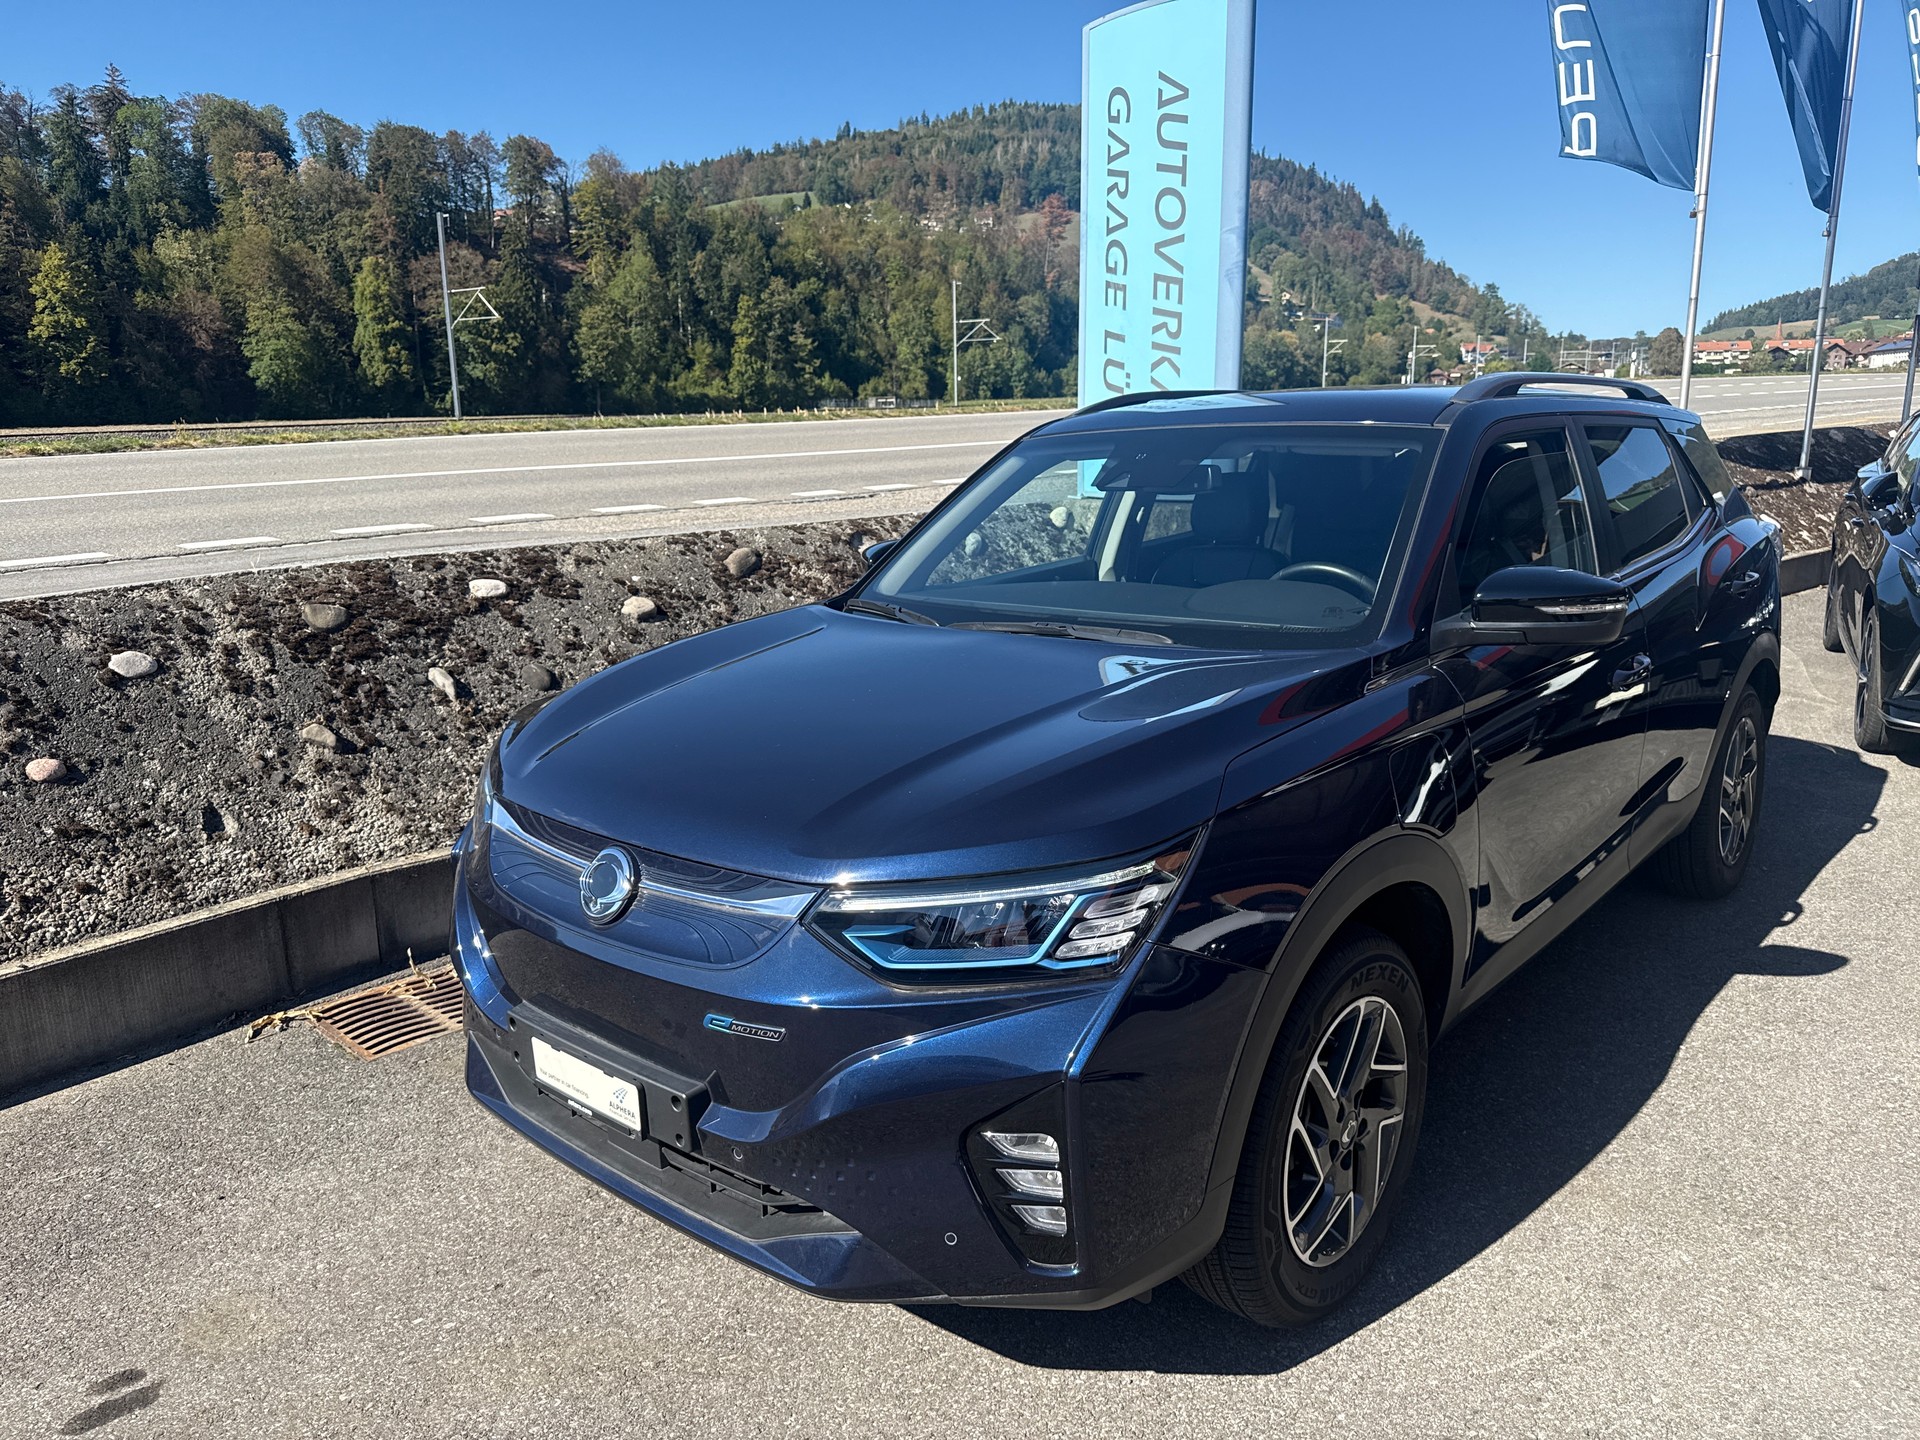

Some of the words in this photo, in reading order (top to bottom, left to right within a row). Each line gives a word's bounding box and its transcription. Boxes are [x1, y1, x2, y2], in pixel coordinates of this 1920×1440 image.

[1104, 86, 1132, 312] GARAGE
[1350, 965, 1409, 992] NEXEN
[609, 1101, 636, 1119] ALPHERA
